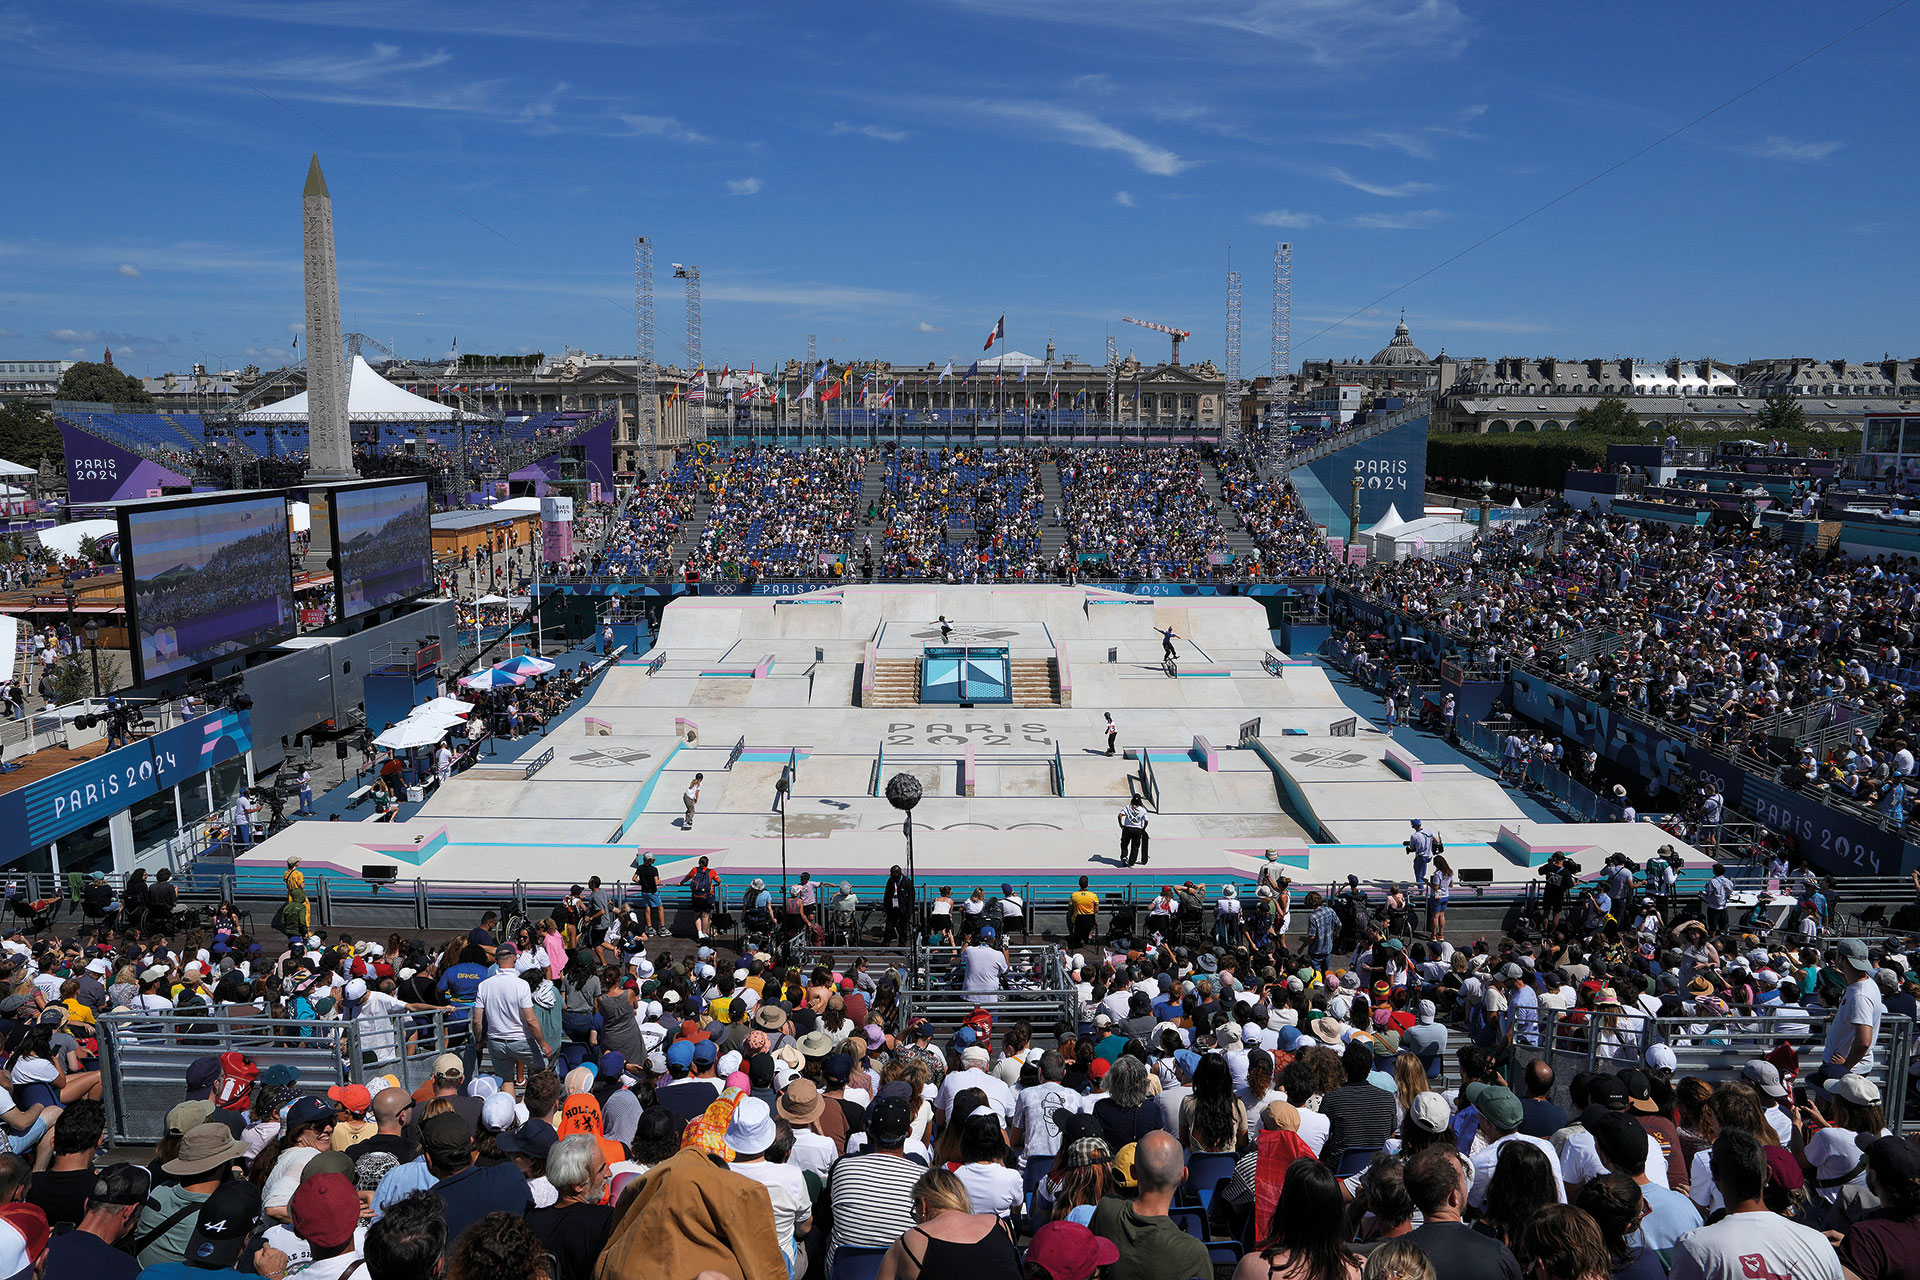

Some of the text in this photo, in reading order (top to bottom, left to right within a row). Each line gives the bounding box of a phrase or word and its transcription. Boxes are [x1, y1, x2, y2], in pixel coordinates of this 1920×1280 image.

[76, 470, 117, 480] 2024
[1358, 476, 1406, 490] 2024
[1132, 585, 1169, 595] 2024
[887, 734, 1052, 746] 2024
[126, 751, 176, 789] 2024
[1820, 828, 1881, 875] 2024
